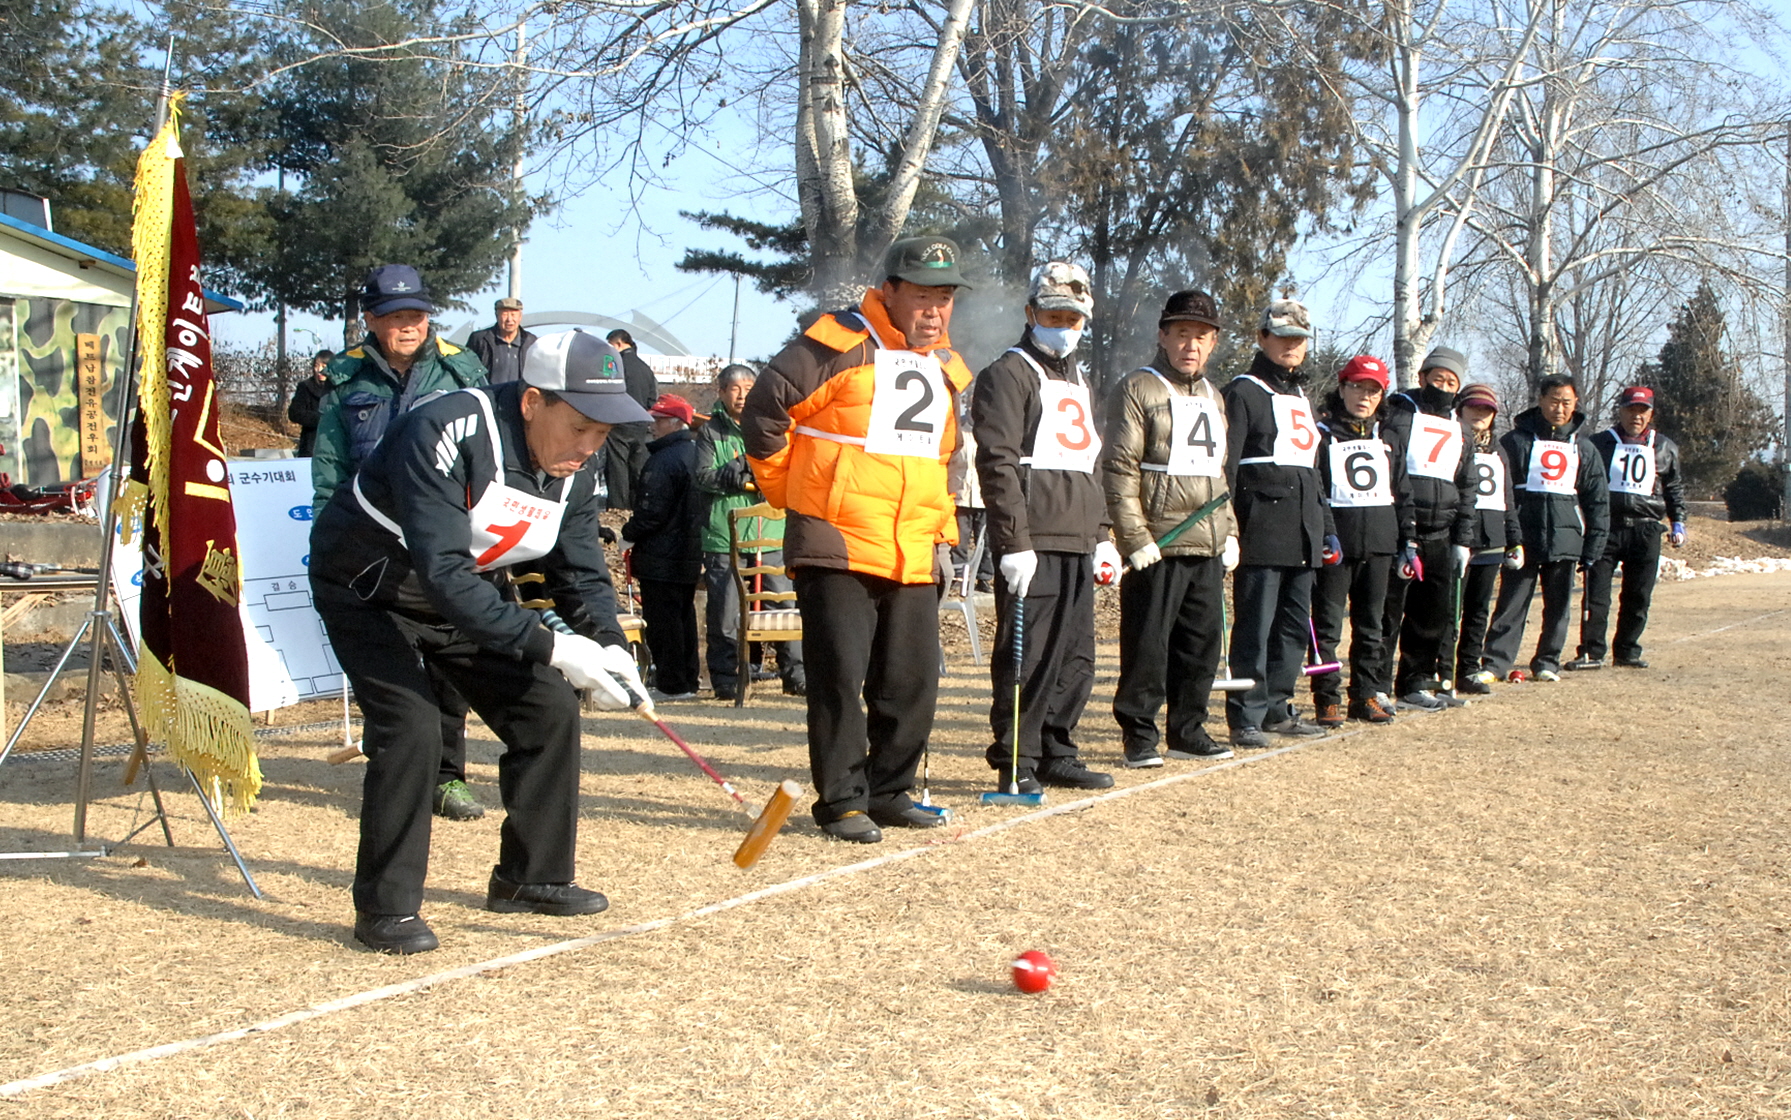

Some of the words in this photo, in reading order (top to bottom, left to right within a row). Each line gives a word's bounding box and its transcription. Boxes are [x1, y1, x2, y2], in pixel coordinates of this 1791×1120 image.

[894, 370, 934, 433] 2
[1056, 397, 1092, 451] 3
[1187, 411, 1217, 457] 4
[1290, 408, 1315, 451] 5
[1423, 426, 1453, 463] 7
[239, 470, 297, 485] 군수기대회
[1344, 451, 1378, 491] 6
[1475, 463, 1497, 496] 8
[1540, 449, 1568, 481] 9
[1619, 453, 1647, 483] 10
[485, 519, 532, 567] 1
